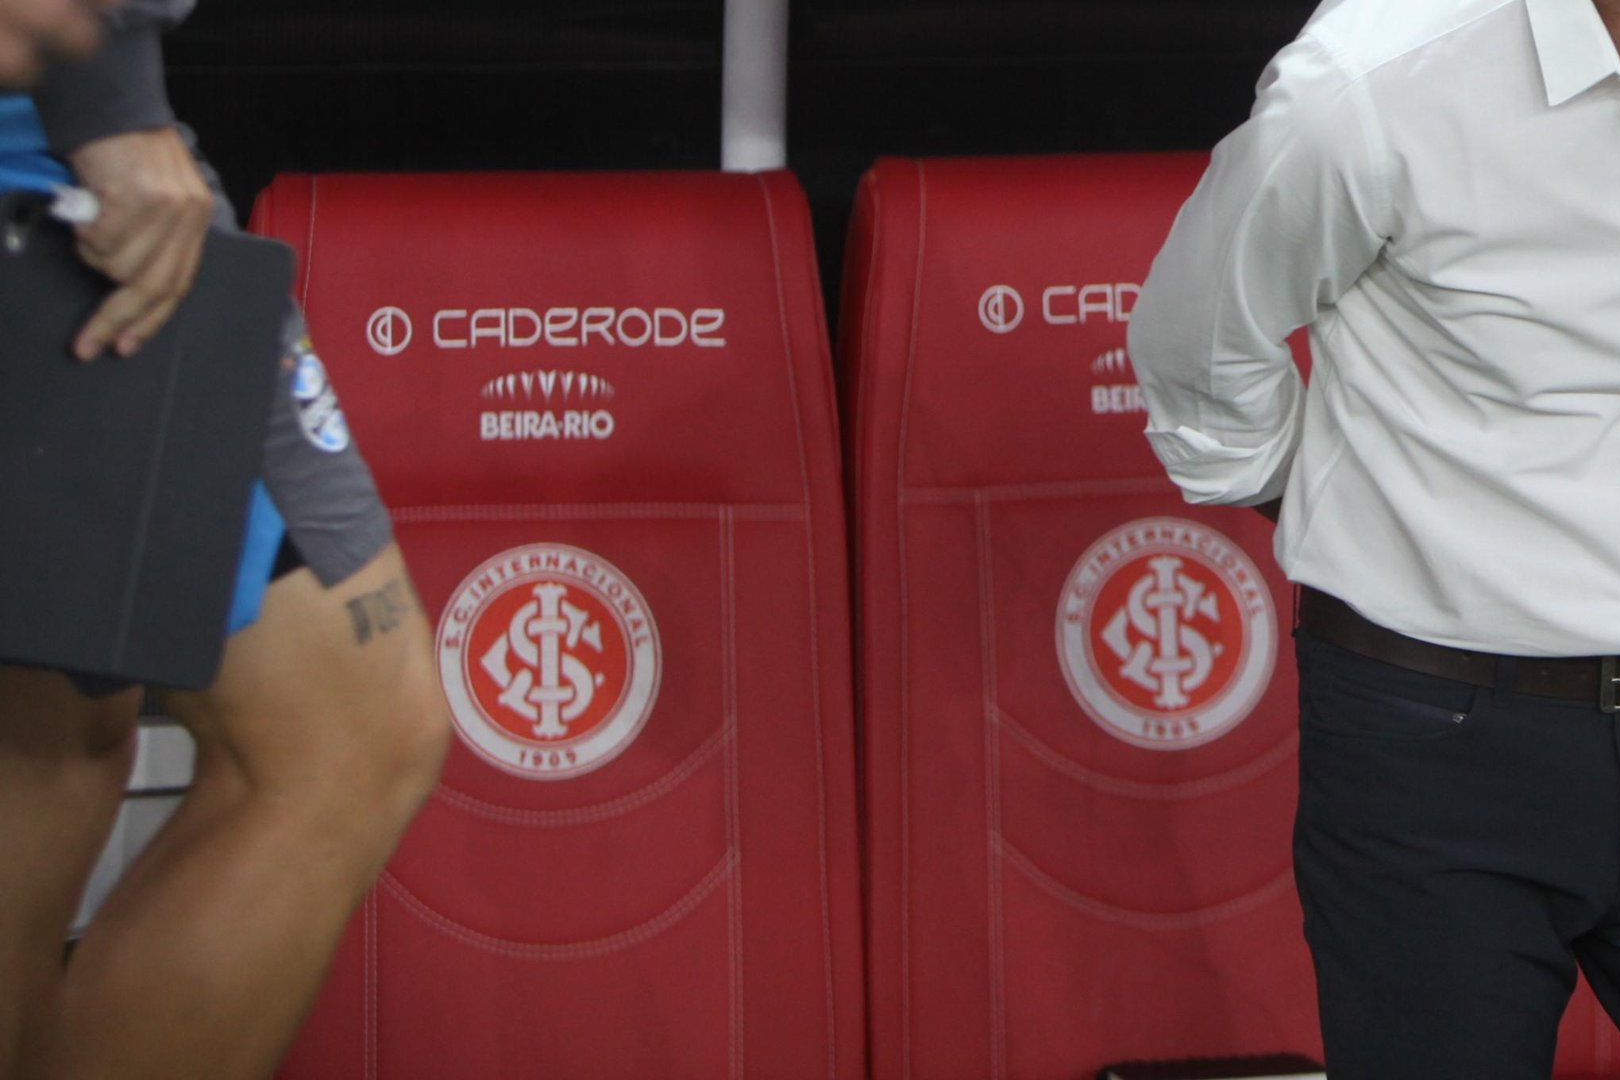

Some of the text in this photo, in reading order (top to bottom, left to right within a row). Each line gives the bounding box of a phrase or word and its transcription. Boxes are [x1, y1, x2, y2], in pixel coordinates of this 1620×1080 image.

[1042, 283, 1141, 325] CAD
[432, 307, 727, 348] CADERODE
[469, 551, 649, 648] INTERNACIONAL
